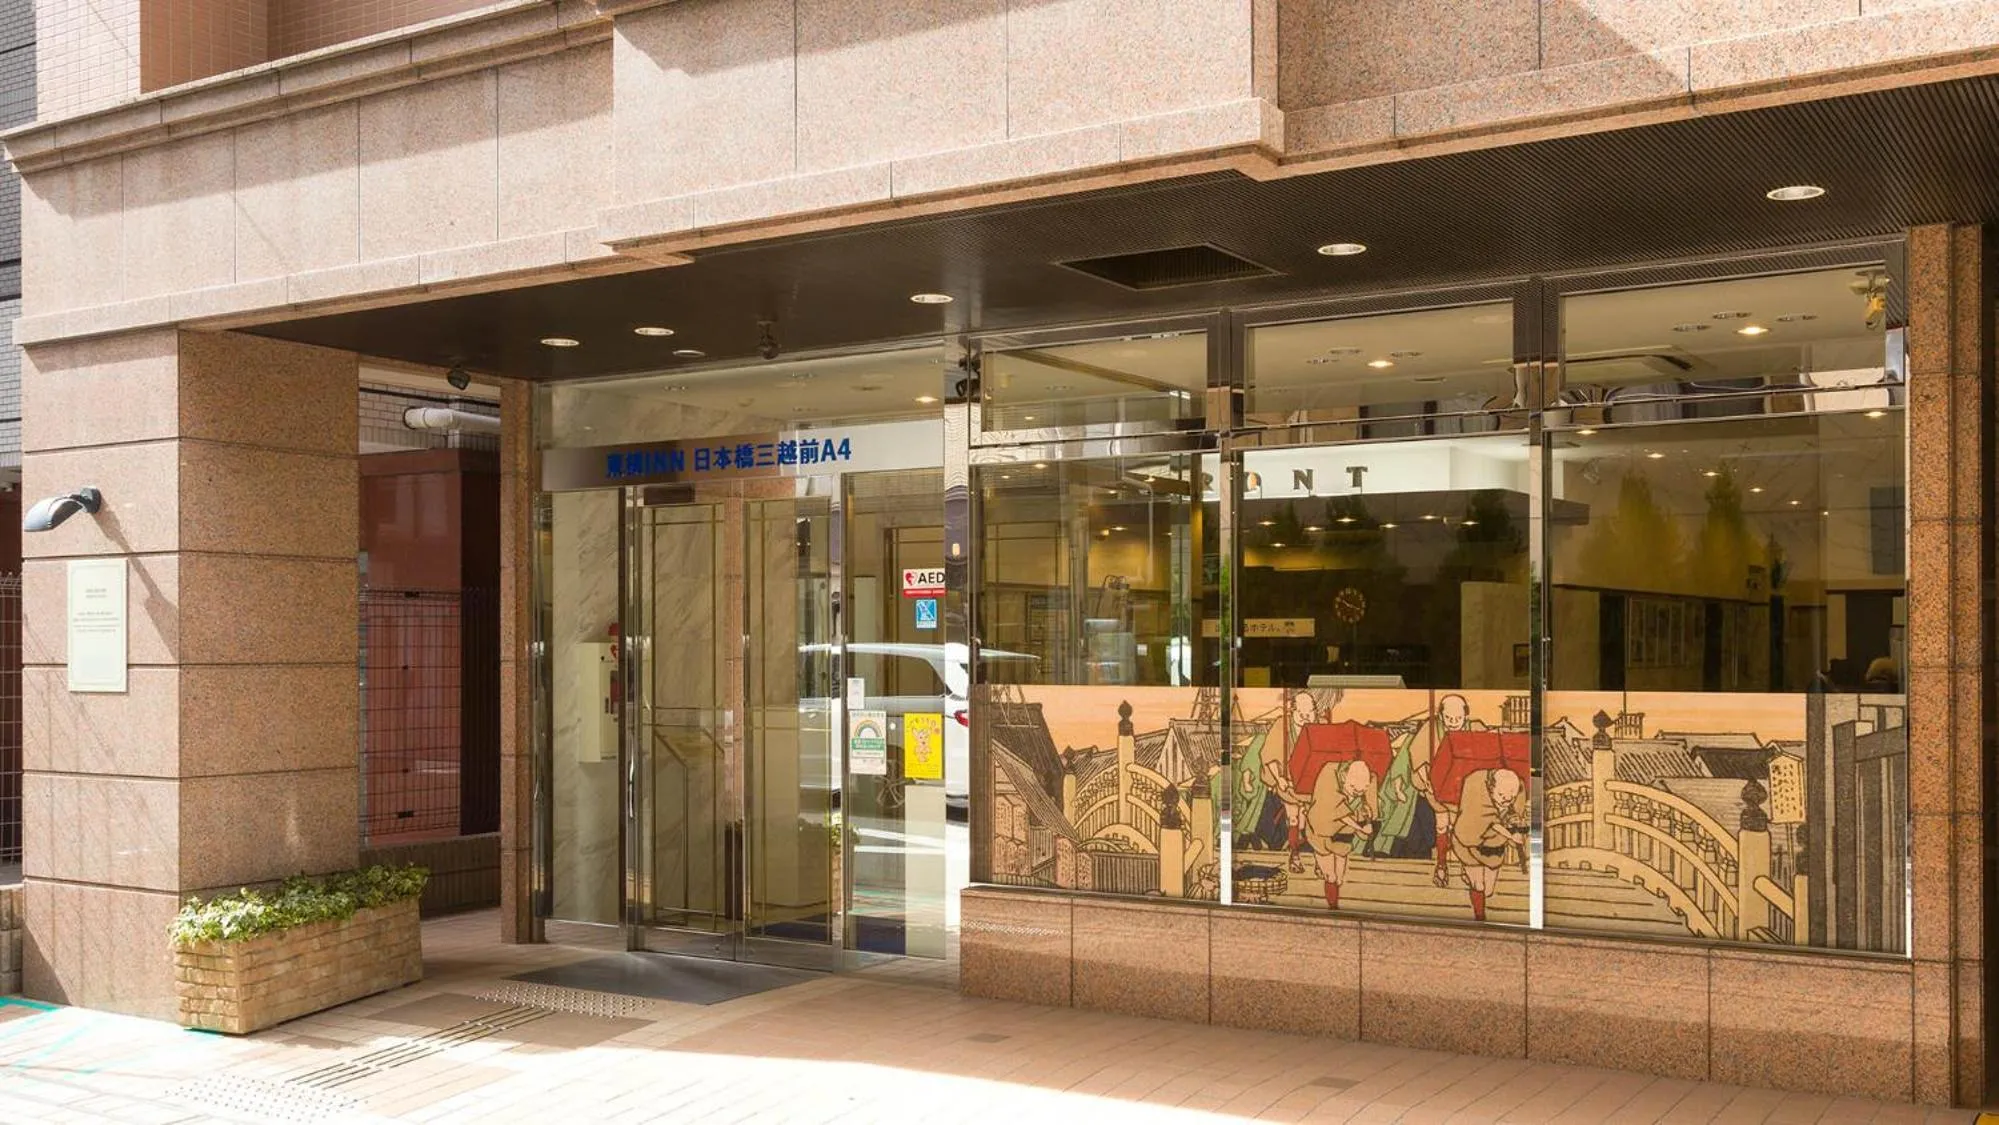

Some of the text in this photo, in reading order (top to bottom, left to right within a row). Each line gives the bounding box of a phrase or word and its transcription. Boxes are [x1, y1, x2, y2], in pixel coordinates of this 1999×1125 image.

[694, 438, 852, 471] 日本橋三越前A4
[1202, 466, 1368, 492] RONT
[917, 572, 945, 584] AED
